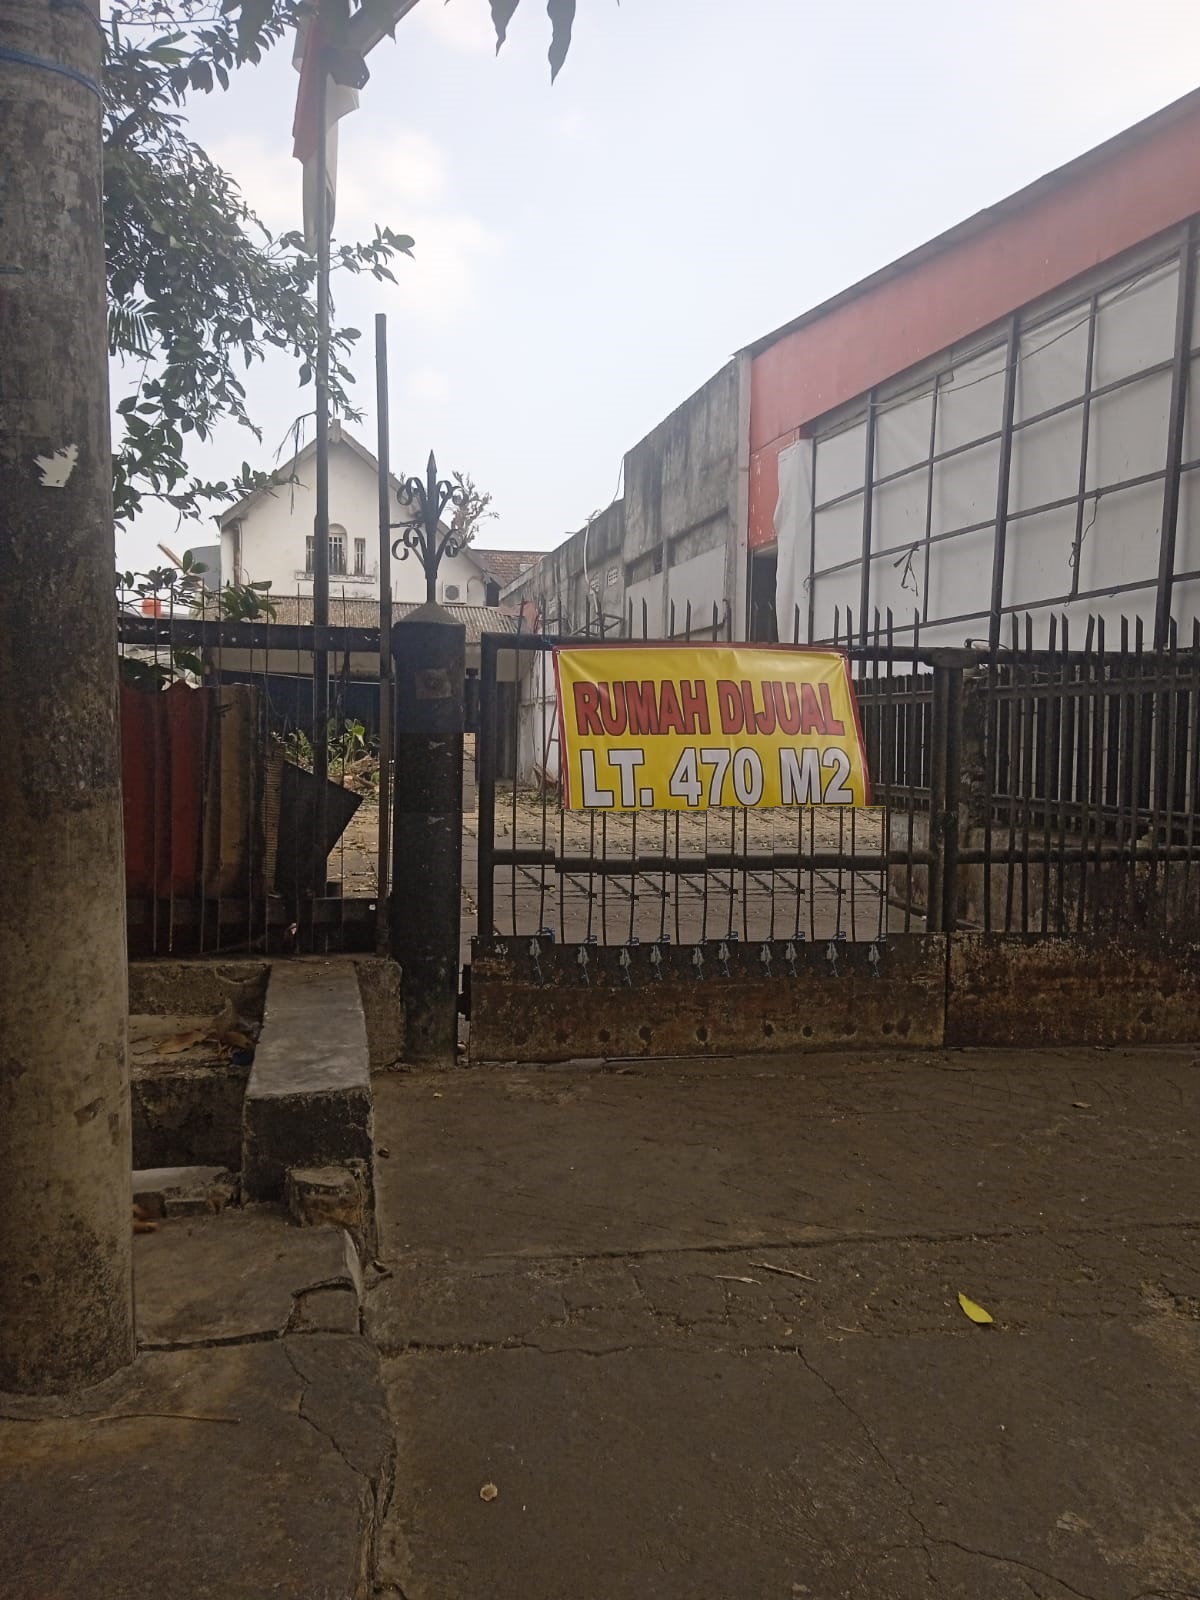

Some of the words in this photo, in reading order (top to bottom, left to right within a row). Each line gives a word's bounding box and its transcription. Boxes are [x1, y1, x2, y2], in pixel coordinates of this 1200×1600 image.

[572, 680, 711, 736] RUMAH
[716, 680, 845, 736] DIJUAL
[580, 748, 654, 807] LT.
[669, 746, 764, 806] 470
[779, 747, 854, 806] M2
